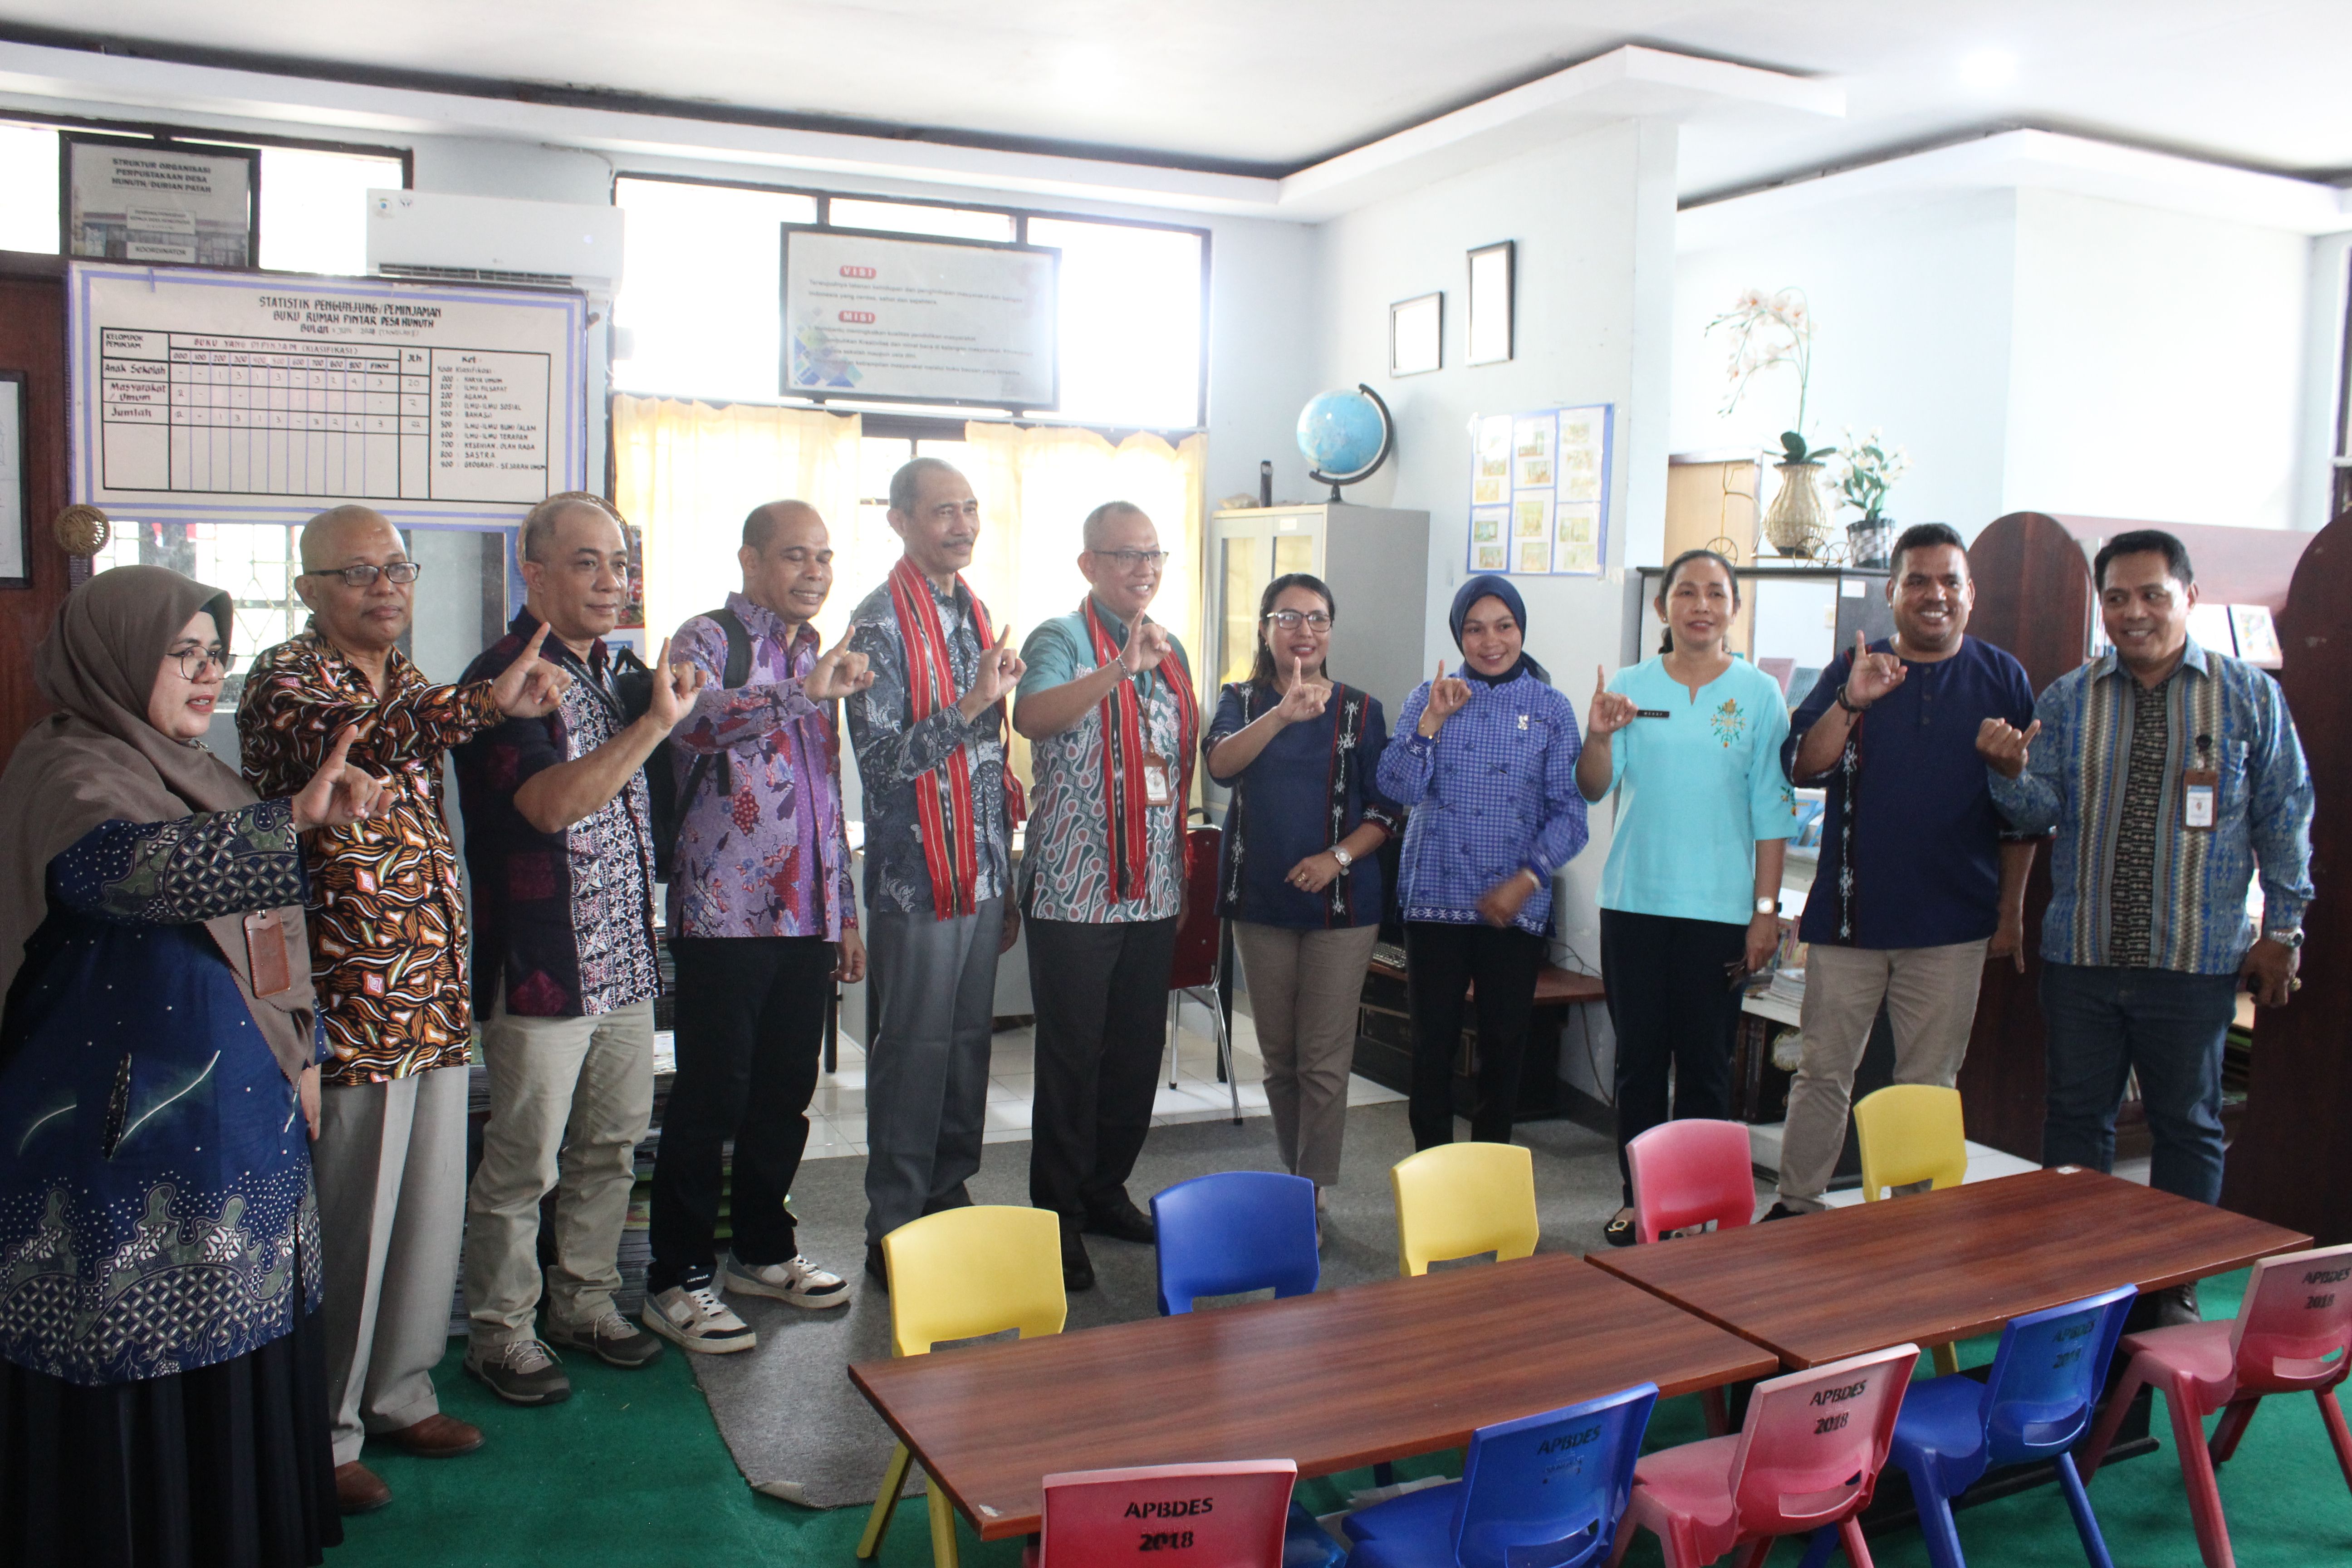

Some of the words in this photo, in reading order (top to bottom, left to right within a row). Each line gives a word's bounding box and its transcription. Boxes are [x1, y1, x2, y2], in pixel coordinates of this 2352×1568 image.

[113, 158, 156, 168] STRUKTUR
[159, 162, 211, 173] ORGANISASI
[116, 168, 183, 180] PERPUSTAKAAN
[185, 175, 207, 183] DESA
[151, 181, 183, 190] DURIAN
[185, 184, 211, 193] PATAH
[135, 246, 186, 255] KOORDINATOR
[843, 266, 872, 277] VISI
[260, 296, 309, 309] STATISTIK
[274, 310, 300, 321] BUKU
[306, 312, 339, 323] RUMAH
[343, 314, 377, 325] PINTAR
[381, 317, 399, 326] DESA
[401, 318, 434, 328] HUNUTH
[843, 312, 872, 322] MISI
[300, 323, 328, 333] Bulan
[106, 333, 143, 342] KELOMPOK
[106, 341, 142, 349] PEMINJAM
[194, 338, 218, 347] BUKU
[225, 340, 245, 348] YANG
[250, 341, 297, 351] DIPINJAM
[105, 364, 126, 372] Anak
[130, 364, 166, 375] Sekolah
[111, 382, 166, 393] Masyarakat
[111, 407, 152, 417] Jumlah
[2302, 1267, 2351, 1284] APBDES
[2304, 1293, 2335, 1309] 2018
[2052, 1319, 2096, 1343] APBDES
[1809, 1379, 1867, 1406] APBDES
[1814, 1411, 1849, 1434] 2018
[1537, 1424, 1602, 1455] APBDES
[1124, 1497, 1213, 1519] APBDES
[1139, 1531, 1194, 1552] 2018
